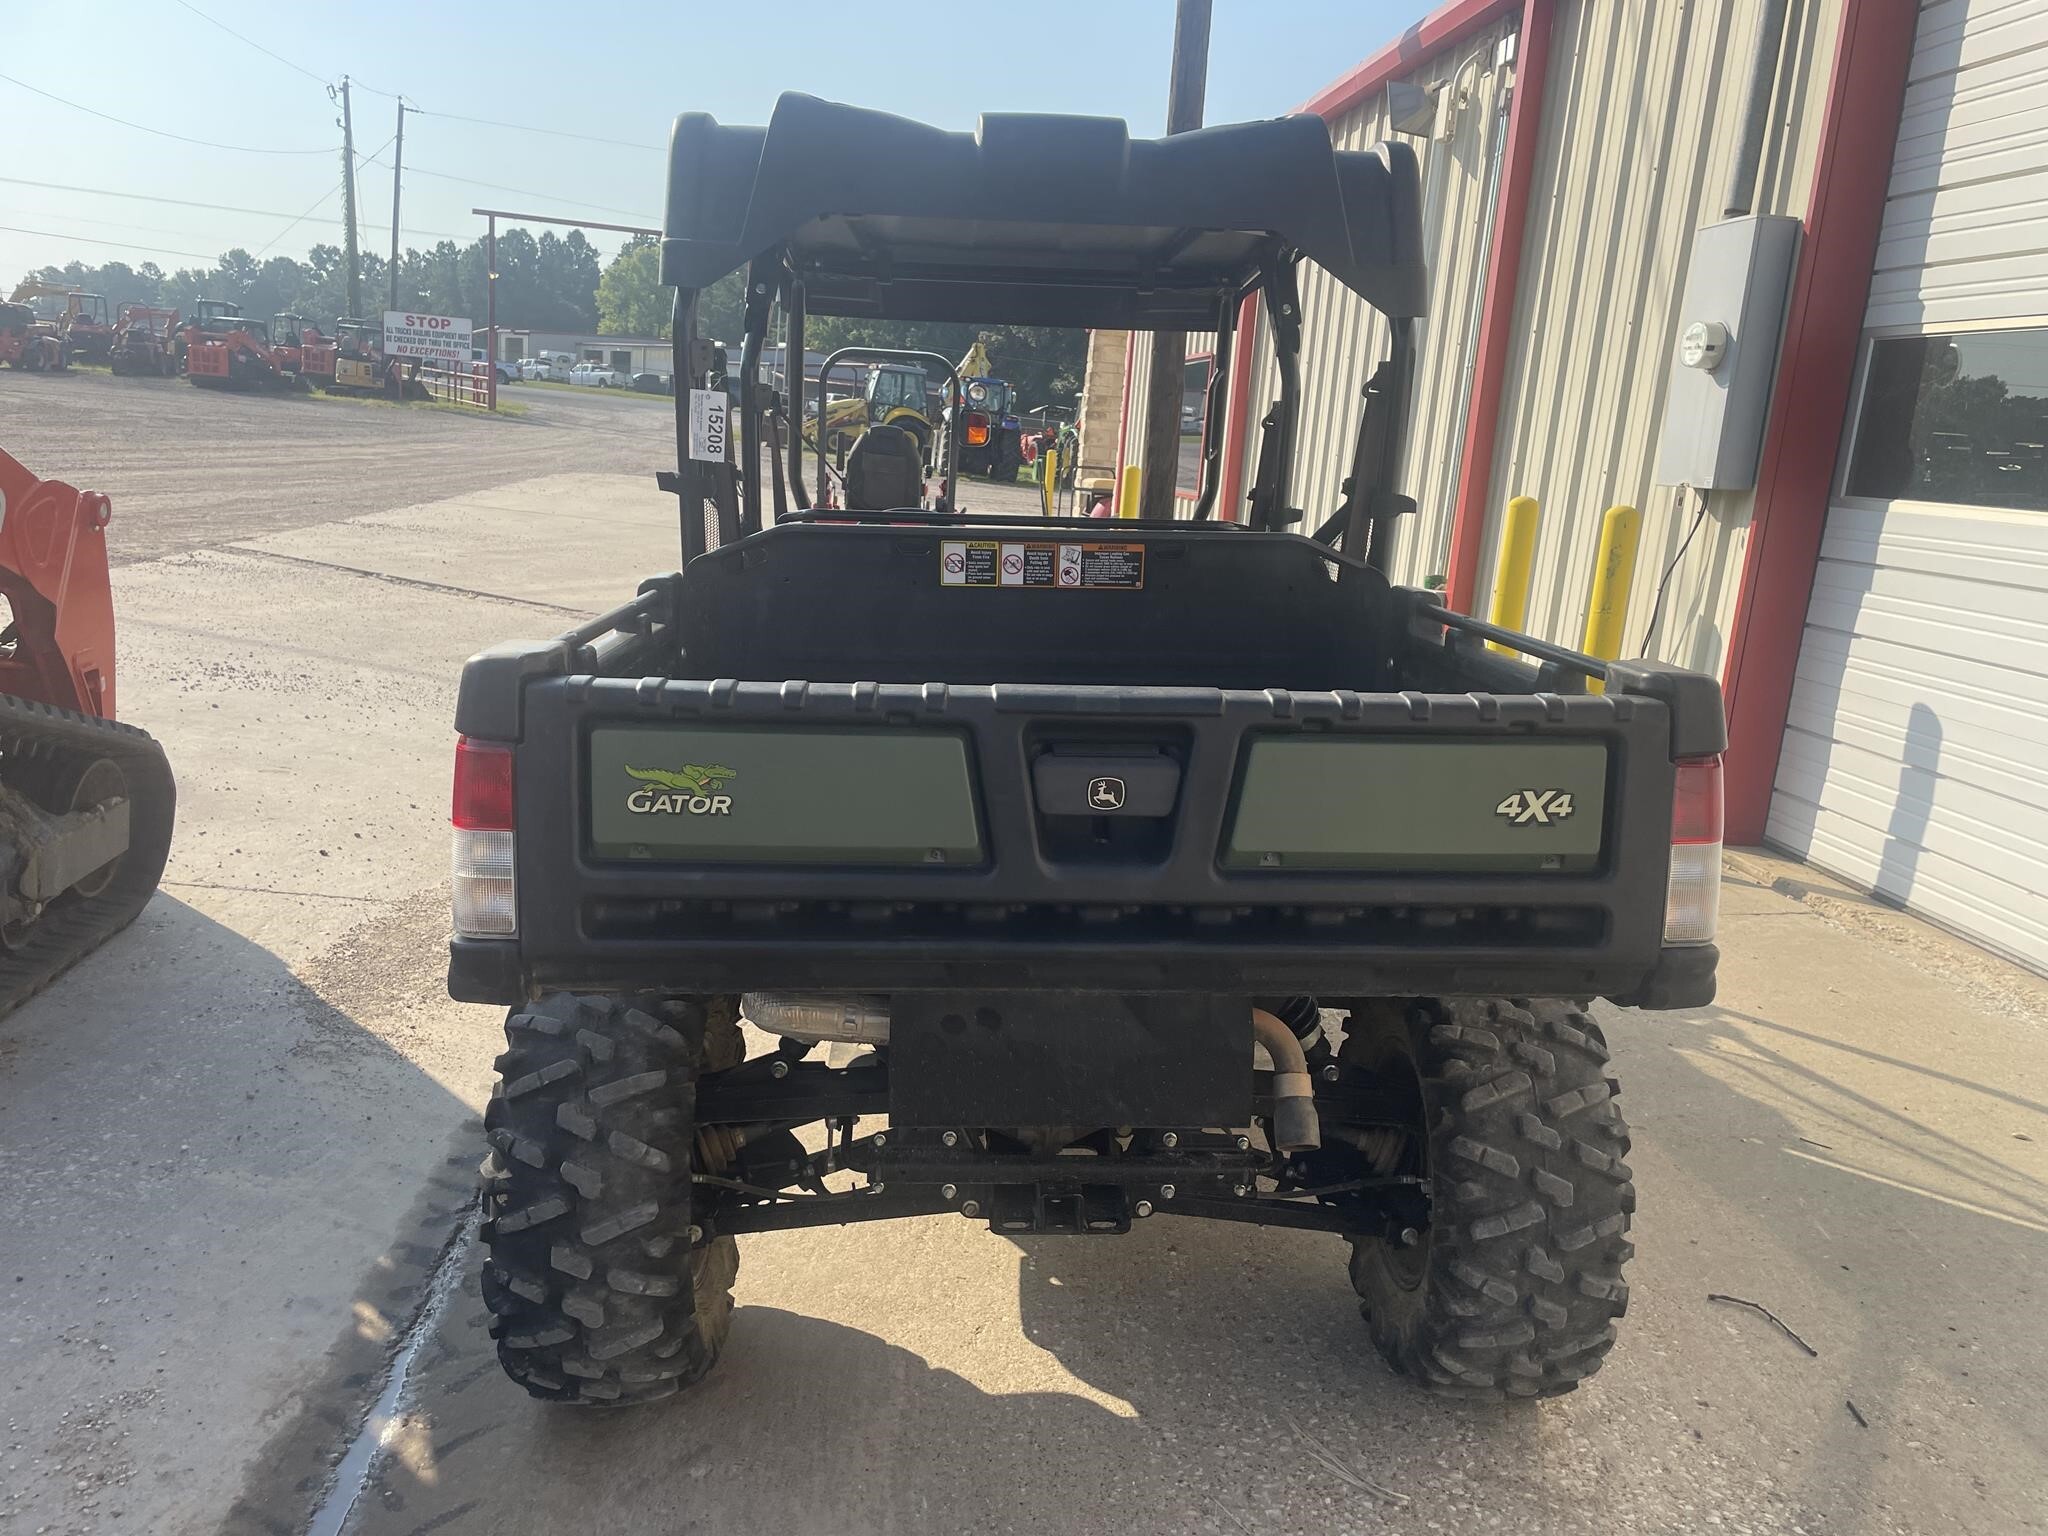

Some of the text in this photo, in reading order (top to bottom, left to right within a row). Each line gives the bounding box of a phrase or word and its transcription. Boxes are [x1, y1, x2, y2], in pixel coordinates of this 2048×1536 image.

[405, 315, 451, 329] STOP
[386, 326, 470, 341] ALL TRUCKS HAULING EQUIPMENT MUST
[394, 335, 416, 344] CHECKED
[417, 337, 427, 346] OUT
[428, 338, 442, 347] THRU
[443, 340, 452, 348] THE
[452, 341, 470, 350] OFFICE
[396, 345, 460, 358] NO EXCEPTIONS!
[707, 406, 724, 454] 15208
[626, 790, 732, 814] GATOR
[1496, 790, 1573, 823] 4X4
